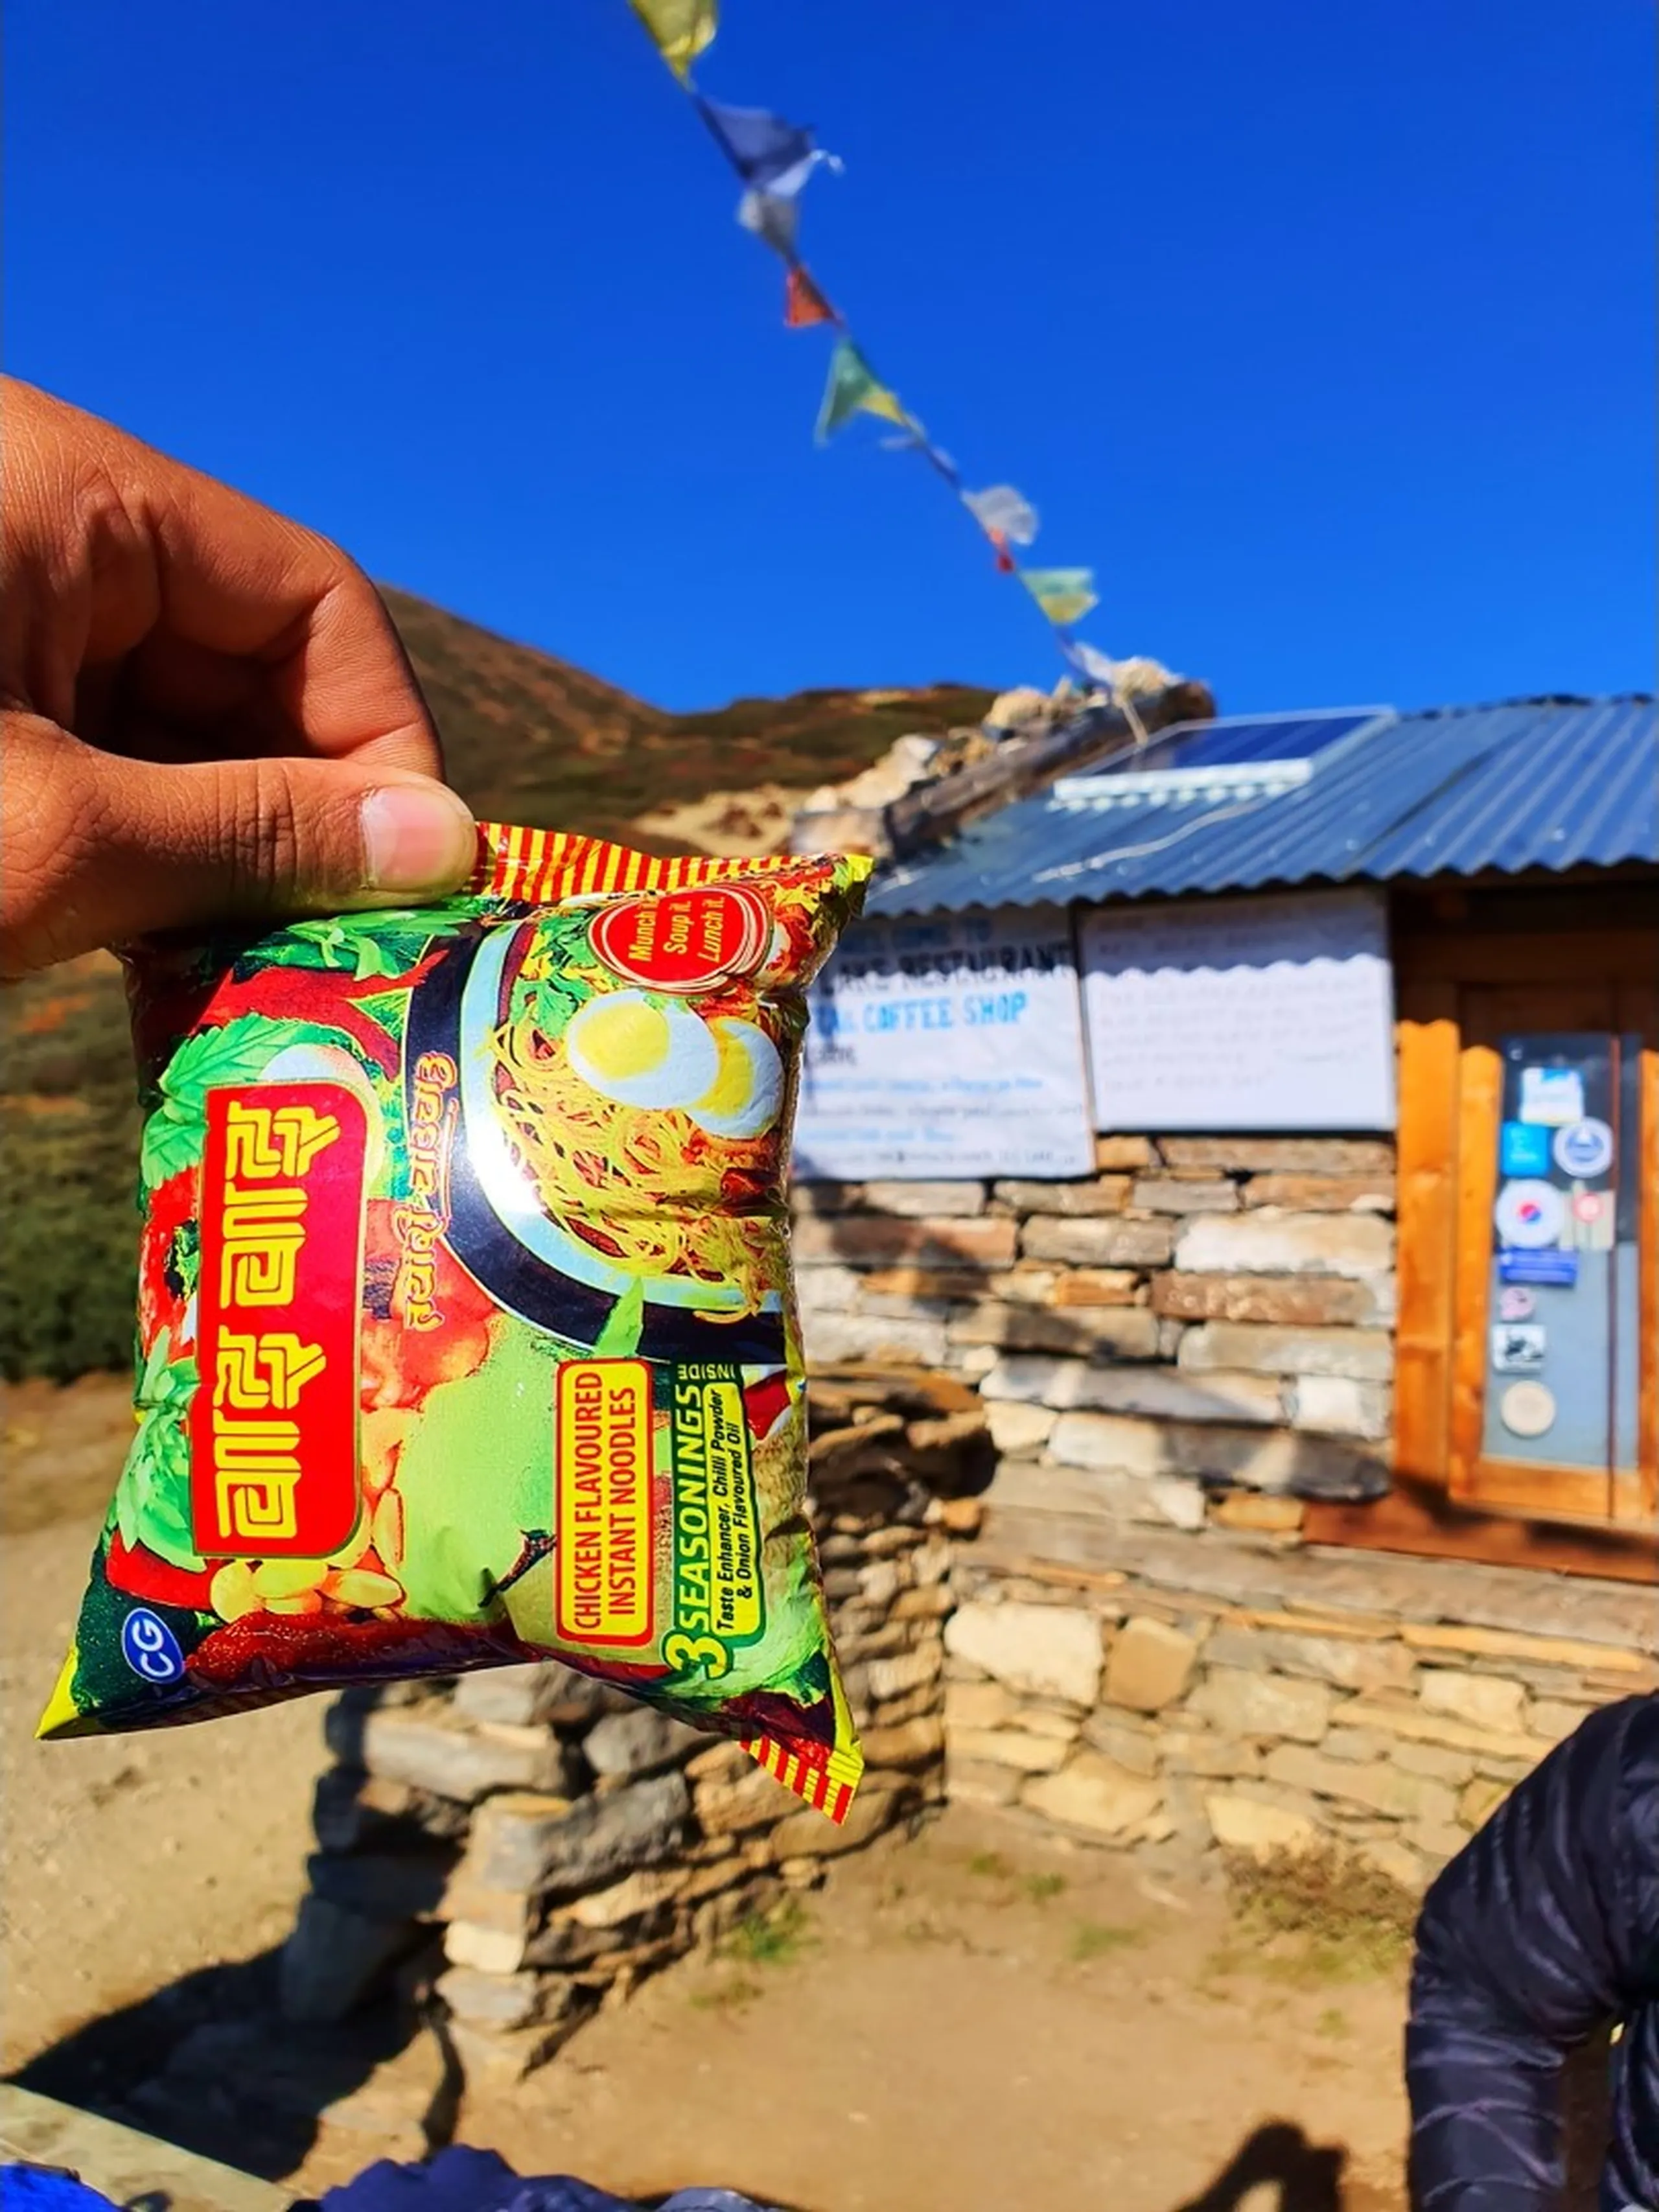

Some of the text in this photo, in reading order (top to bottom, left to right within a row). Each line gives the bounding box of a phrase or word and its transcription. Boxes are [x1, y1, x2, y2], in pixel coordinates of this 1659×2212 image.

[628, 911, 657, 962] Munch
[662, 900, 695, 955] Soup it.
[697, 896, 725, 963] Lunch it.
[863, 995, 953, 1034] COFFEE
[963, 990, 1028, 1026] SHOP
[678, 1364, 735, 1380] INSIDE
[575, 1371, 602, 1629] CHICKEN FLAVOURED
[609, 1388, 636, 1614] INSTANT NOODLES
[664, 1384, 728, 1678] 3 SEASONINGS
[710, 1390, 734, 1629] Taste Enhancer, Chilli Powder
[726, 1423, 752, 1599] & Onion Flavoured Oil
[132, 1619, 175, 1677] CG
